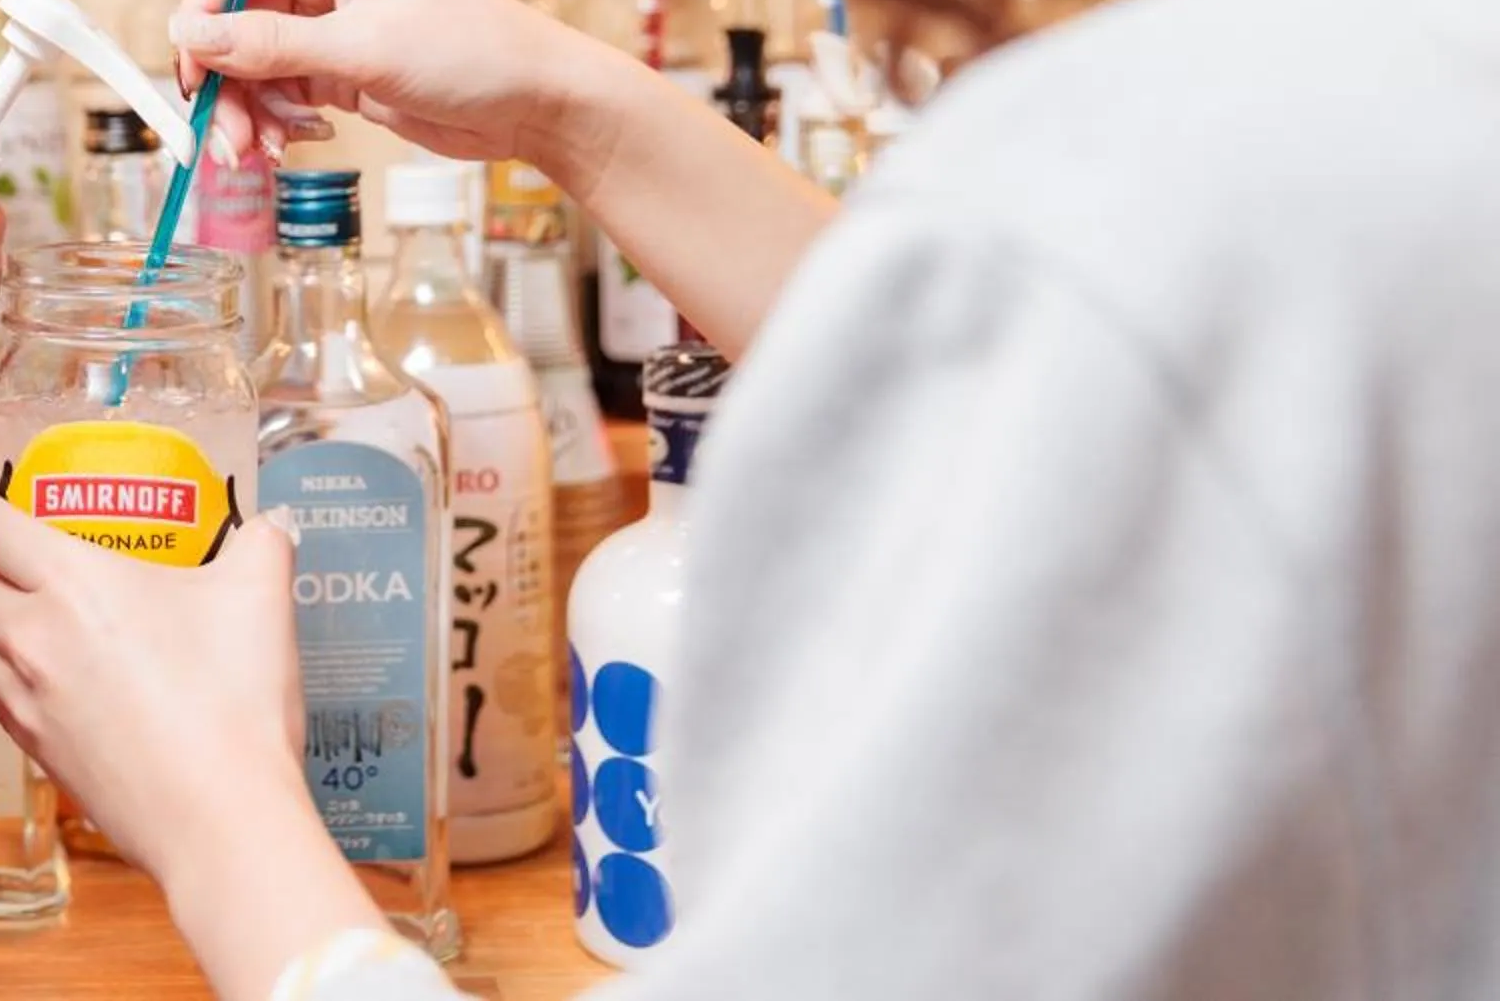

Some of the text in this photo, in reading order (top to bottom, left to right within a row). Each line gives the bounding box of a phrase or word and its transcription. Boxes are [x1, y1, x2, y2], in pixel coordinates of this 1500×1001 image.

[456, 469, 500, 493] RO
[45, 483, 186, 516] SMIRNOFF
[292, 570, 414, 605] ODKA
[321, 765, 379, 791] 40°
[635, 790, 662, 827] Y
